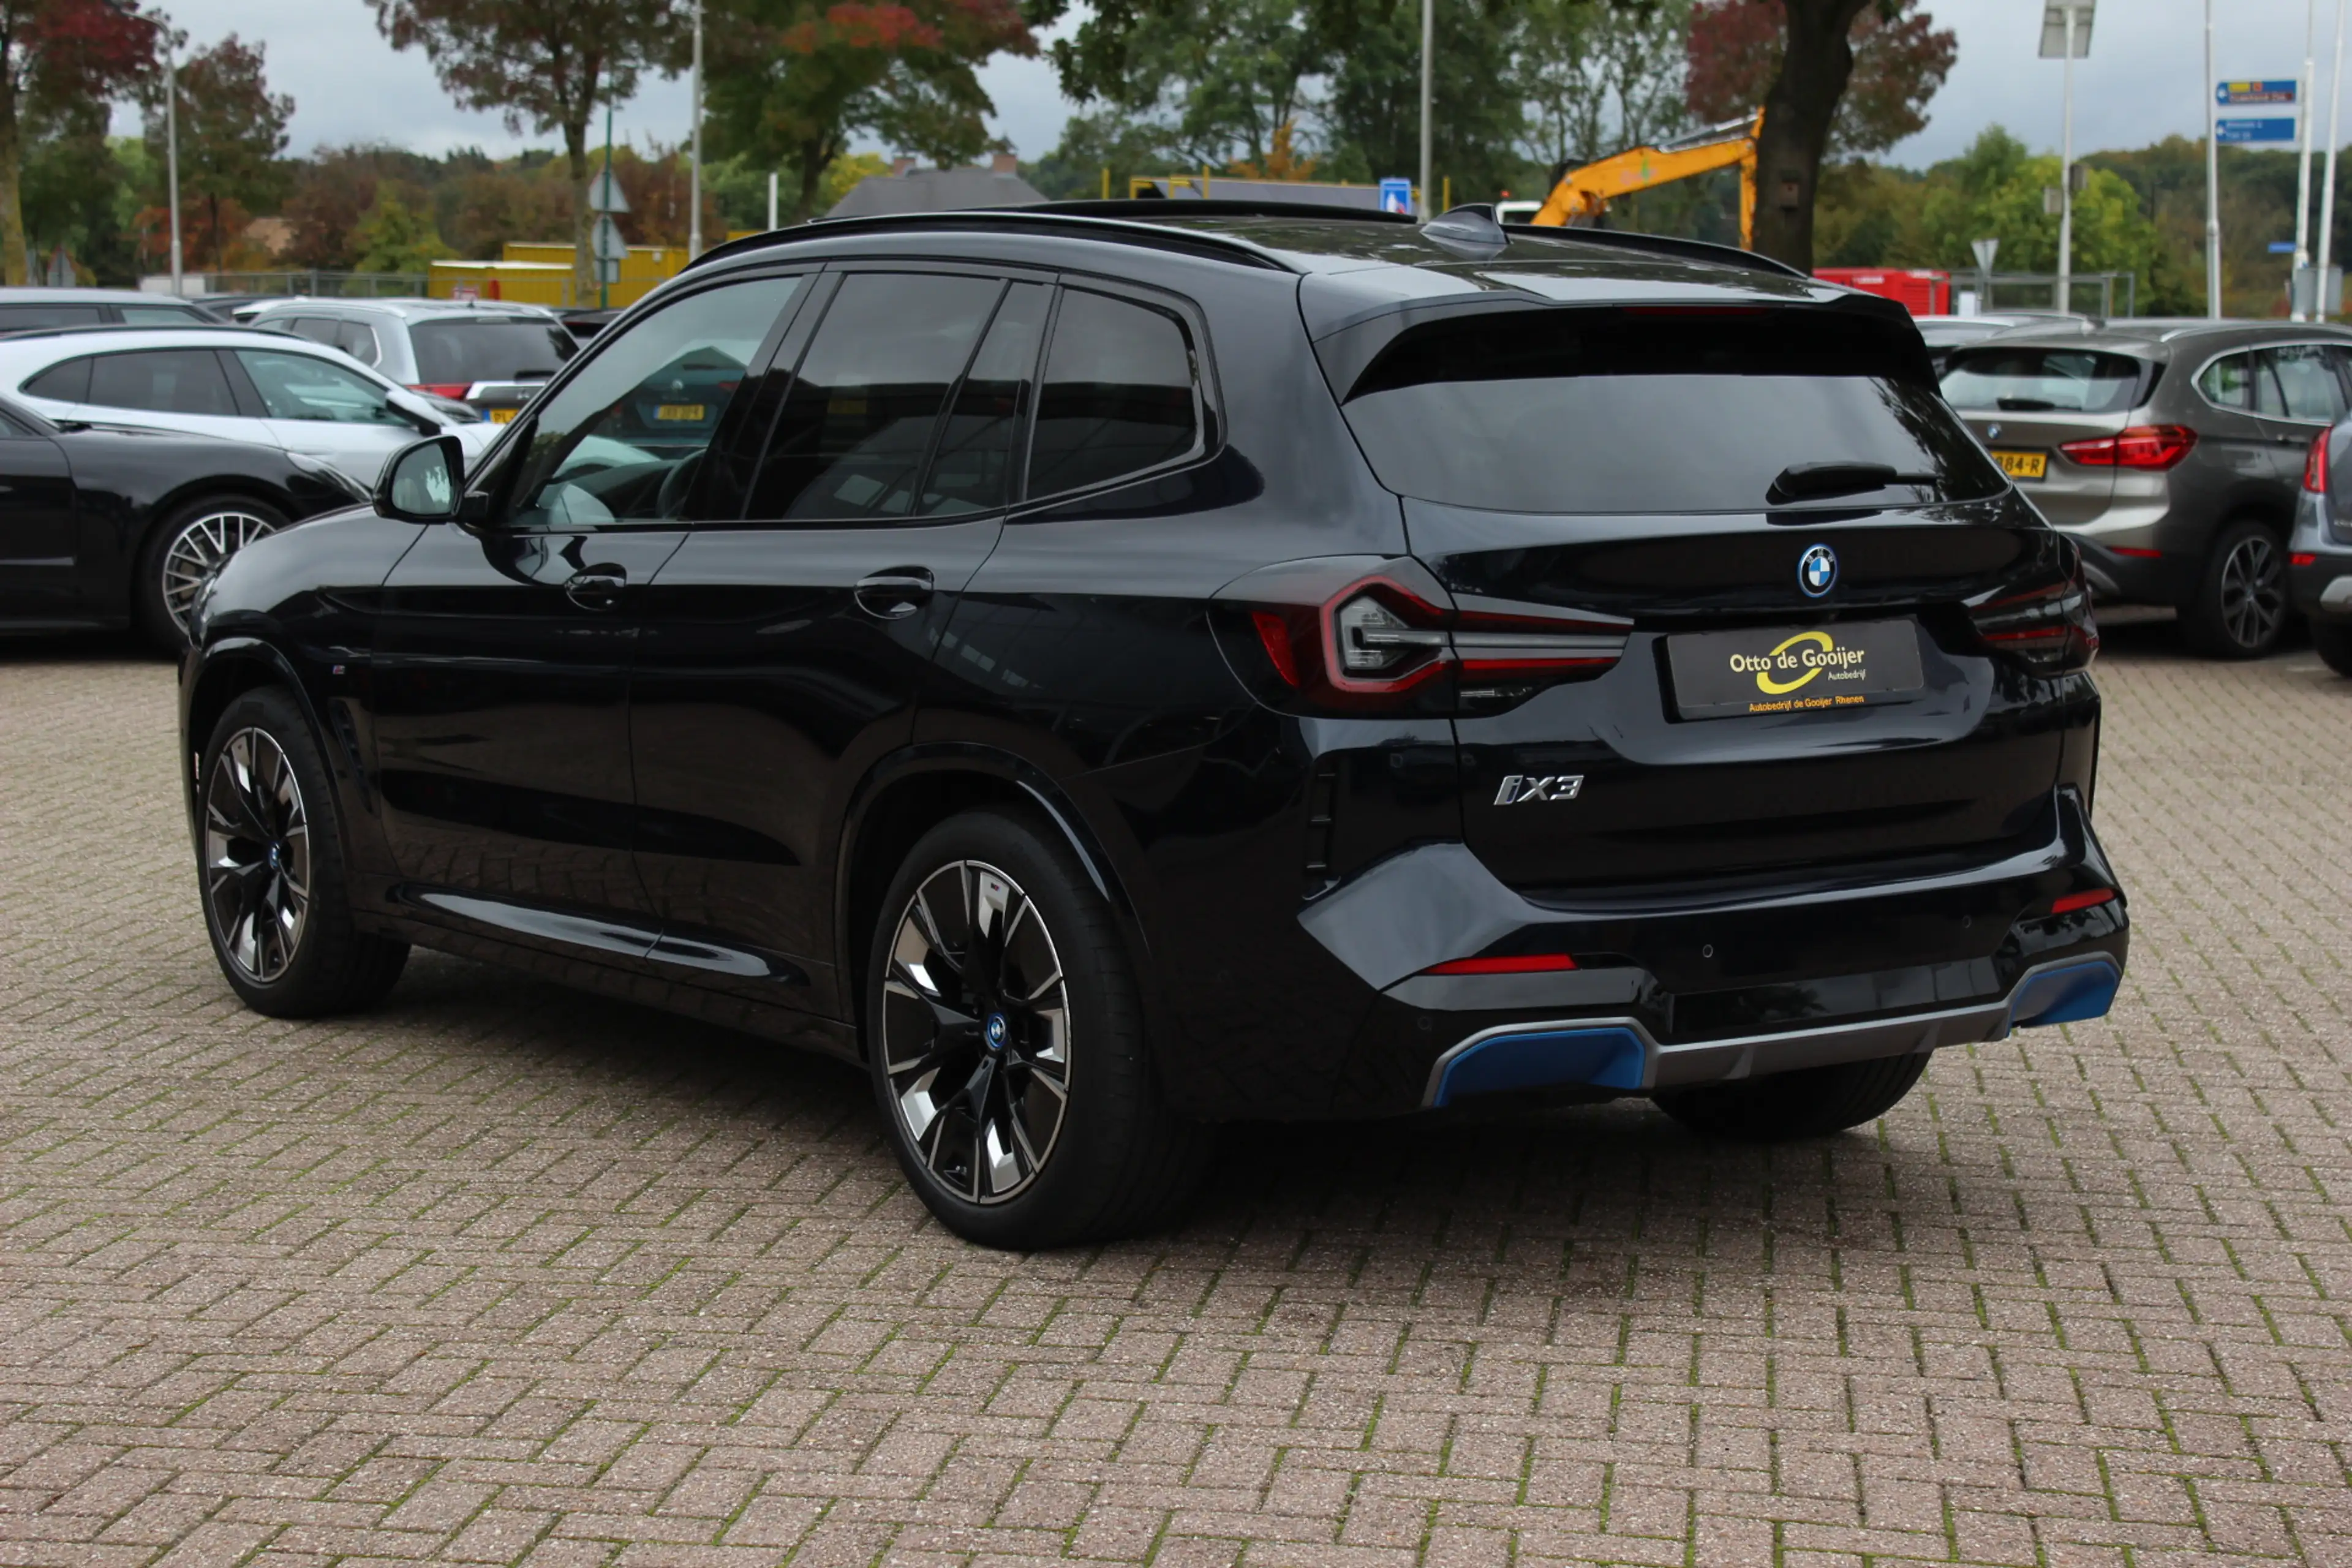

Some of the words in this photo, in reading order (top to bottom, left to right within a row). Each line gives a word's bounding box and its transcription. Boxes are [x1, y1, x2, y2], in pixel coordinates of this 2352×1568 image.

[1730, 654, 1771, 673] Otto
[1777, 650, 1798, 669] de
[1802, 646, 1865, 669] Gooijer
[1828, 669, 1866, 680] Autobedrijf
[1749, 700, 1792, 712] Autobedrijf
[1793, 699, 1804, 709] de
[1804, 698, 1833, 708] Gooijer
[1834, 695, 1864, 705] Rhenen
